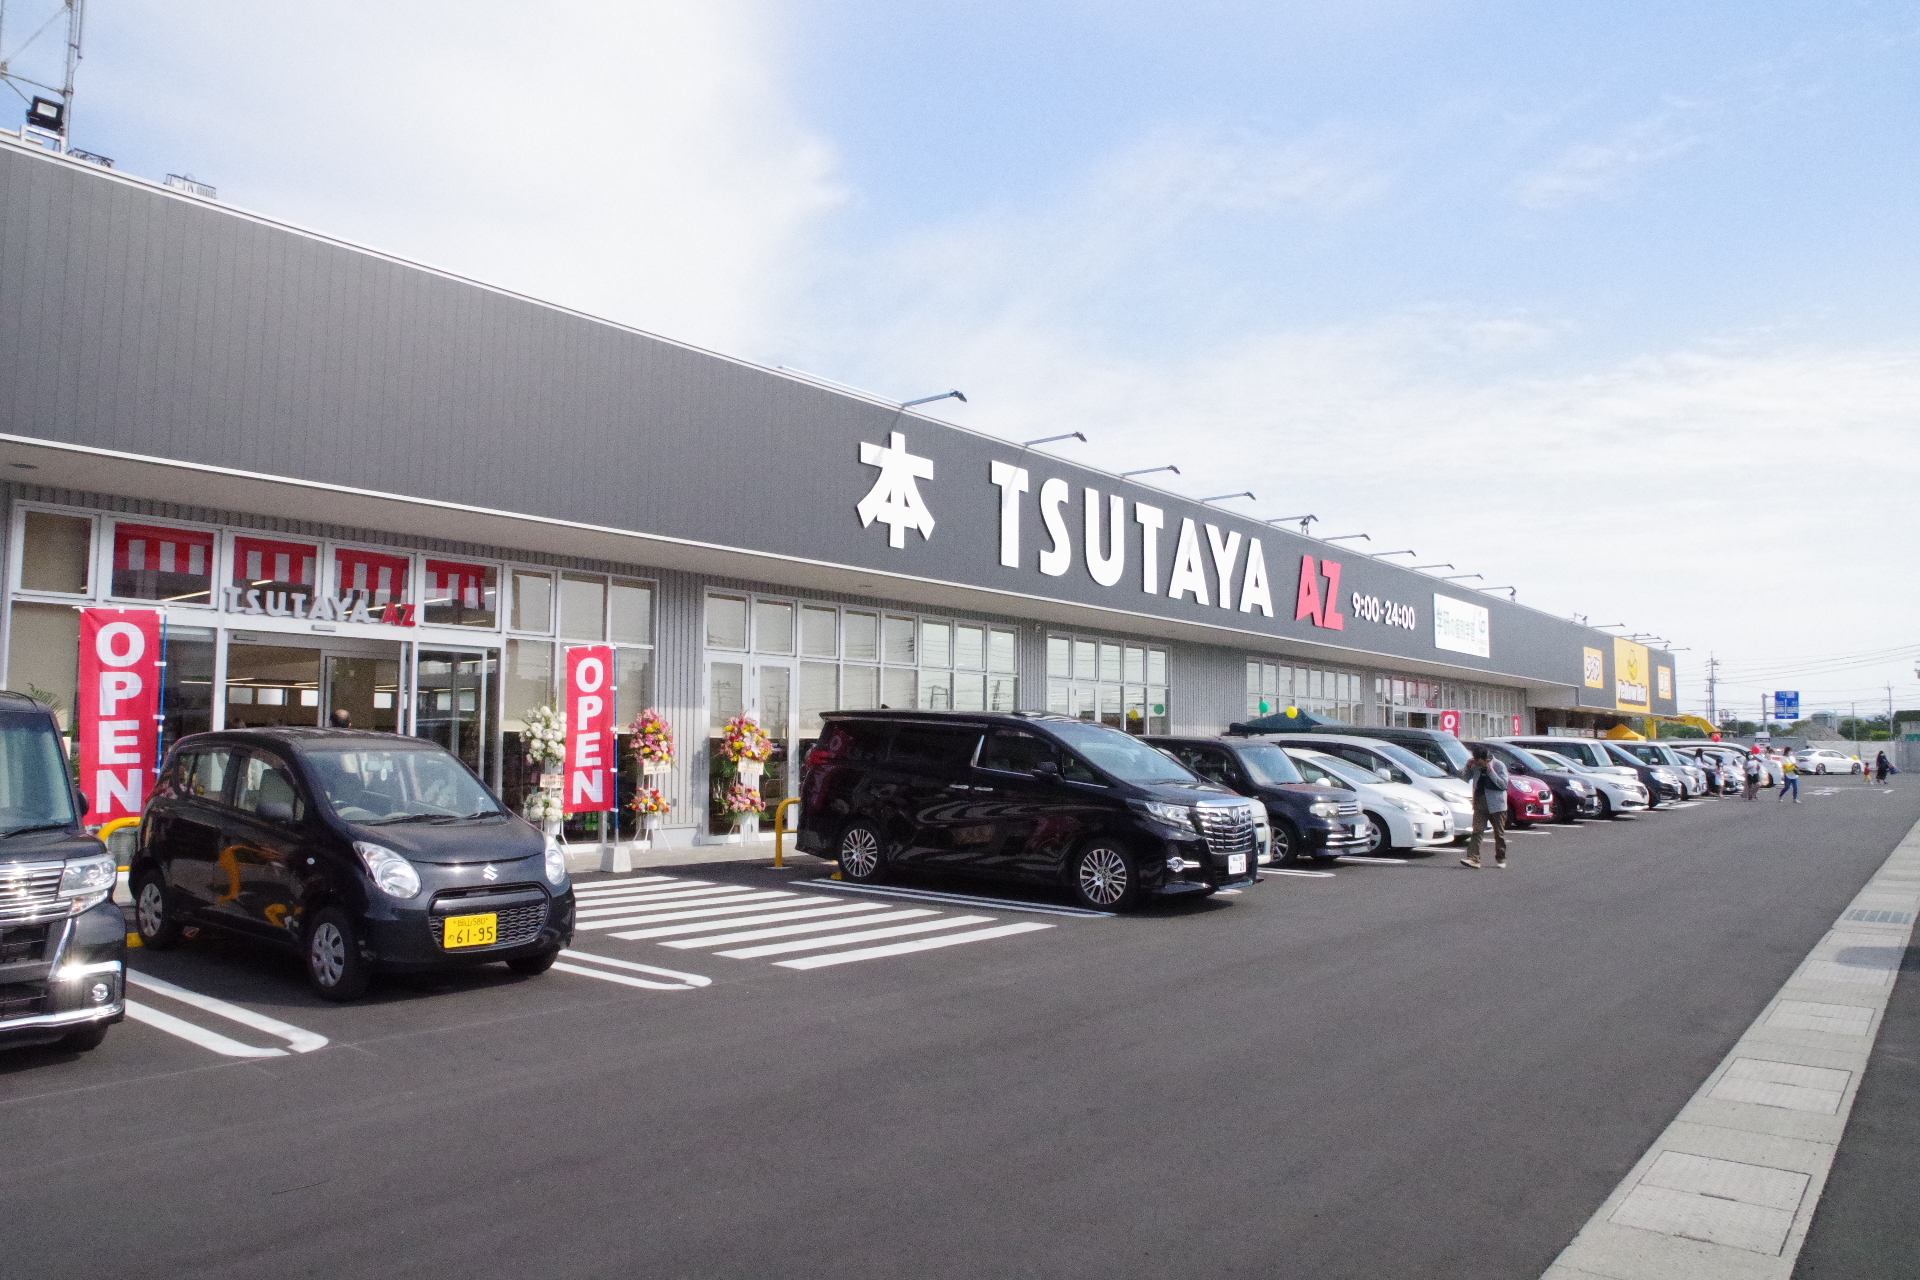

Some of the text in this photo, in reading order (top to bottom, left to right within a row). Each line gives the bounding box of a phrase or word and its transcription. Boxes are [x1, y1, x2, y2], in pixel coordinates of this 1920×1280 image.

[856, 431, 936, 550] 本
[991, 459, 1345, 631] TSUTAYA AZ
[225, 586, 416, 627] TSUTAYA AZ
[1352, 591, 1415, 631] 9:00-24:00
[95, 621, 146, 814] OPEN
[572, 657, 604, 805] OPEN
[456, 926, 494, 944] 61-95
